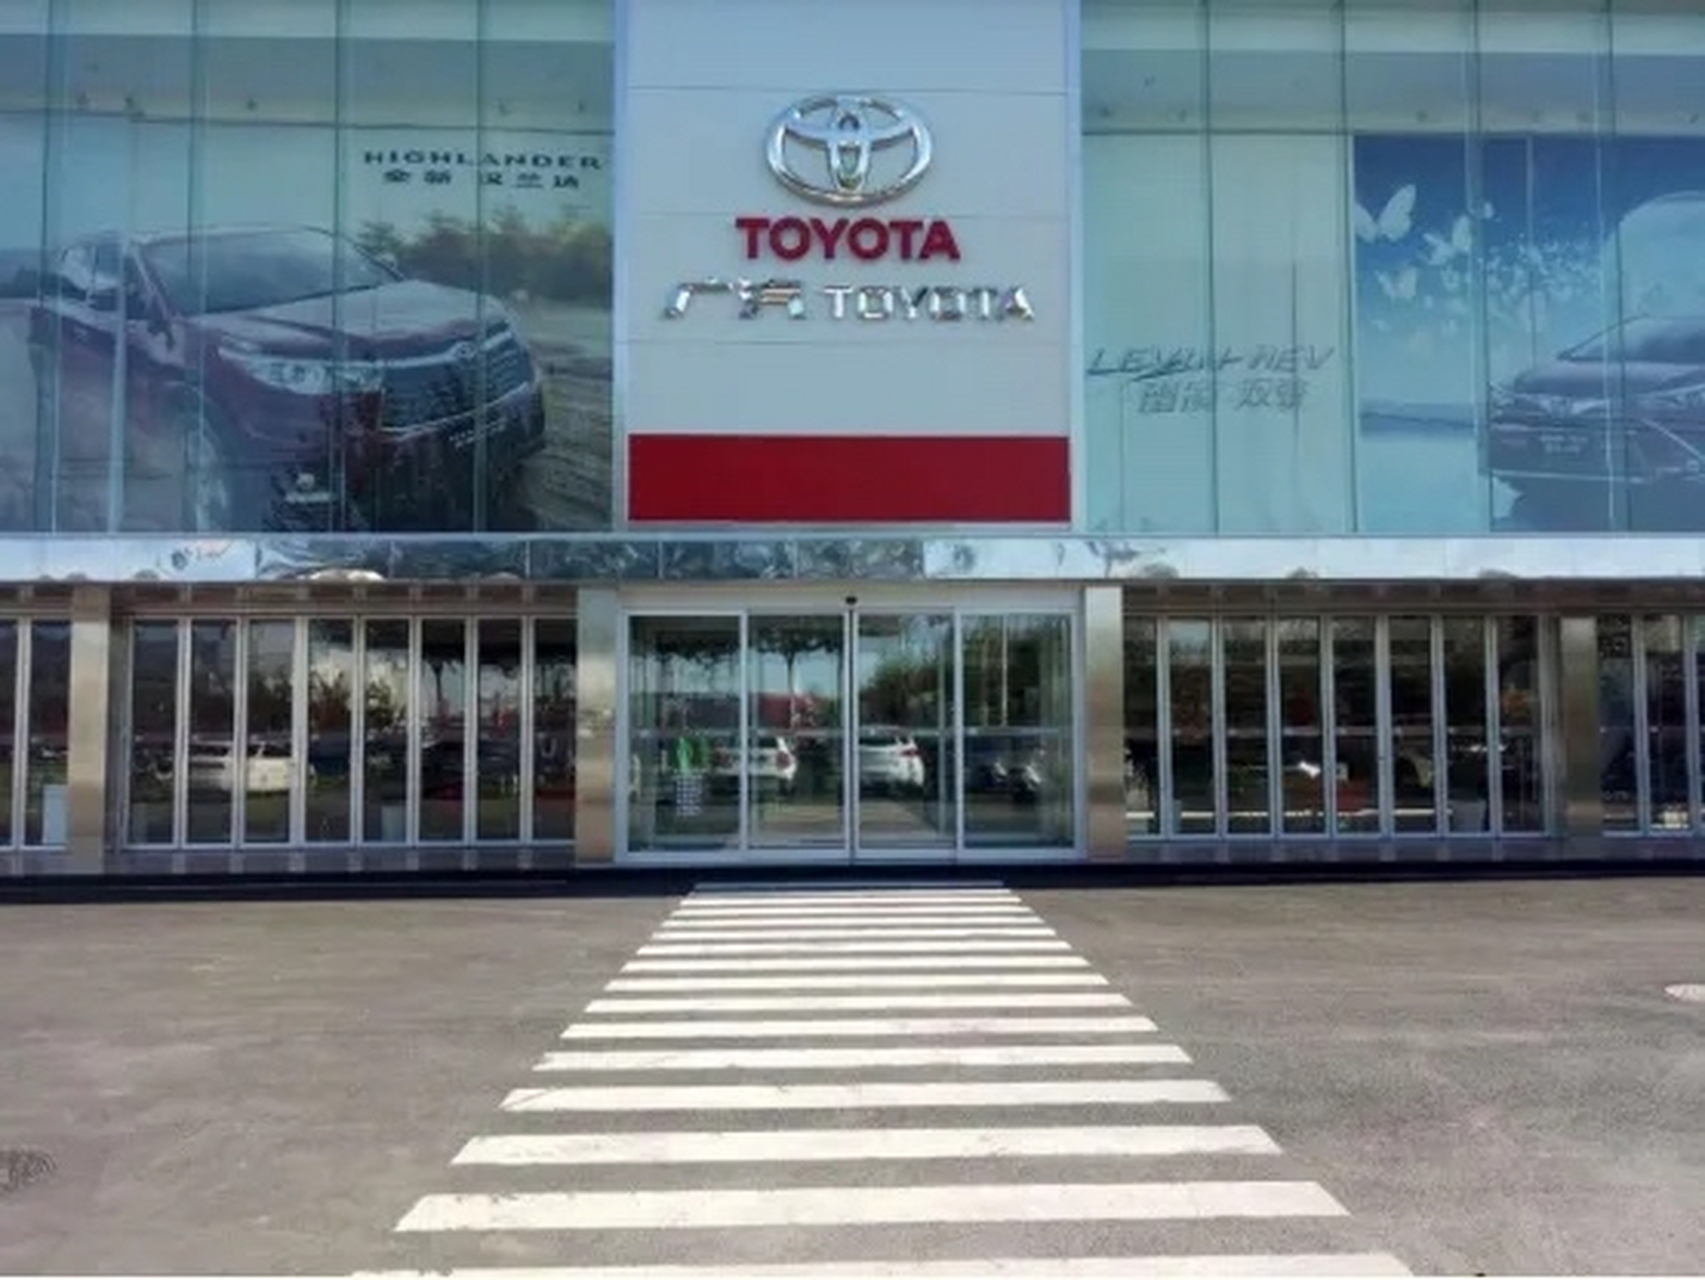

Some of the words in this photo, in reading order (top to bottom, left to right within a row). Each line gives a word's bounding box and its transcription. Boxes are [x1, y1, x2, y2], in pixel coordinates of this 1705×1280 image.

[364, 151, 602, 170] HIGHLANDER
[735, 217, 961, 261] TOYOTA
[663, 278, 807, 321] 广汽
[823, 284, 1035, 322] TOYOTA
